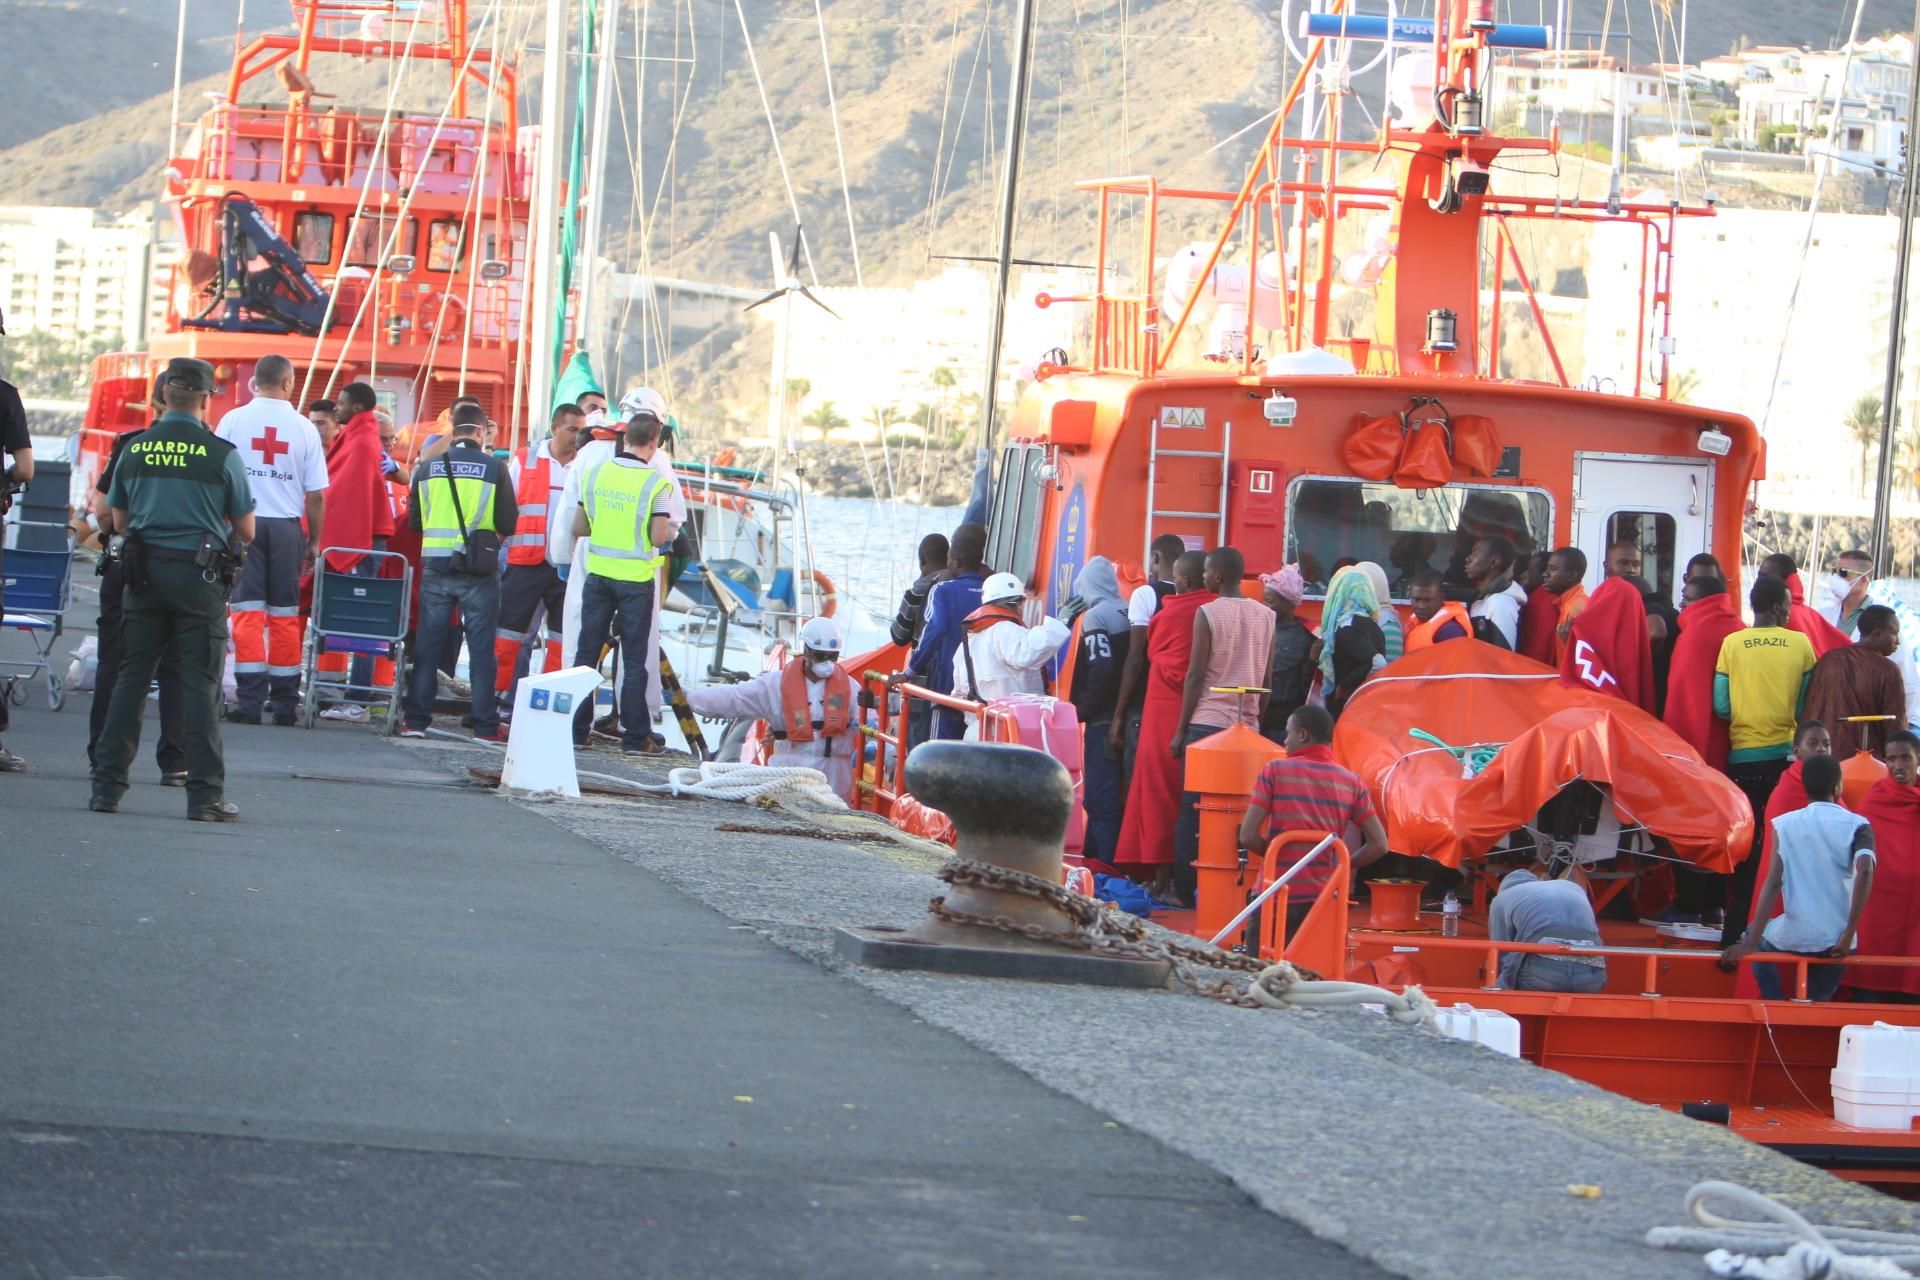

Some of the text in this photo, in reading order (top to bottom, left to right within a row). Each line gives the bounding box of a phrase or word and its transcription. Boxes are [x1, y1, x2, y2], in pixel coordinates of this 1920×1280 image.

[130, 440, 208, 457] GUARDIA
[144, 453, 188, 468] CIVIL
[271, 469, 293, 481] Roja
[594, 488, 637, 504] GUARDIA
[1084, 633, 1112, 661] 75
[1743, 637, 1789, 649] BRAZIL
